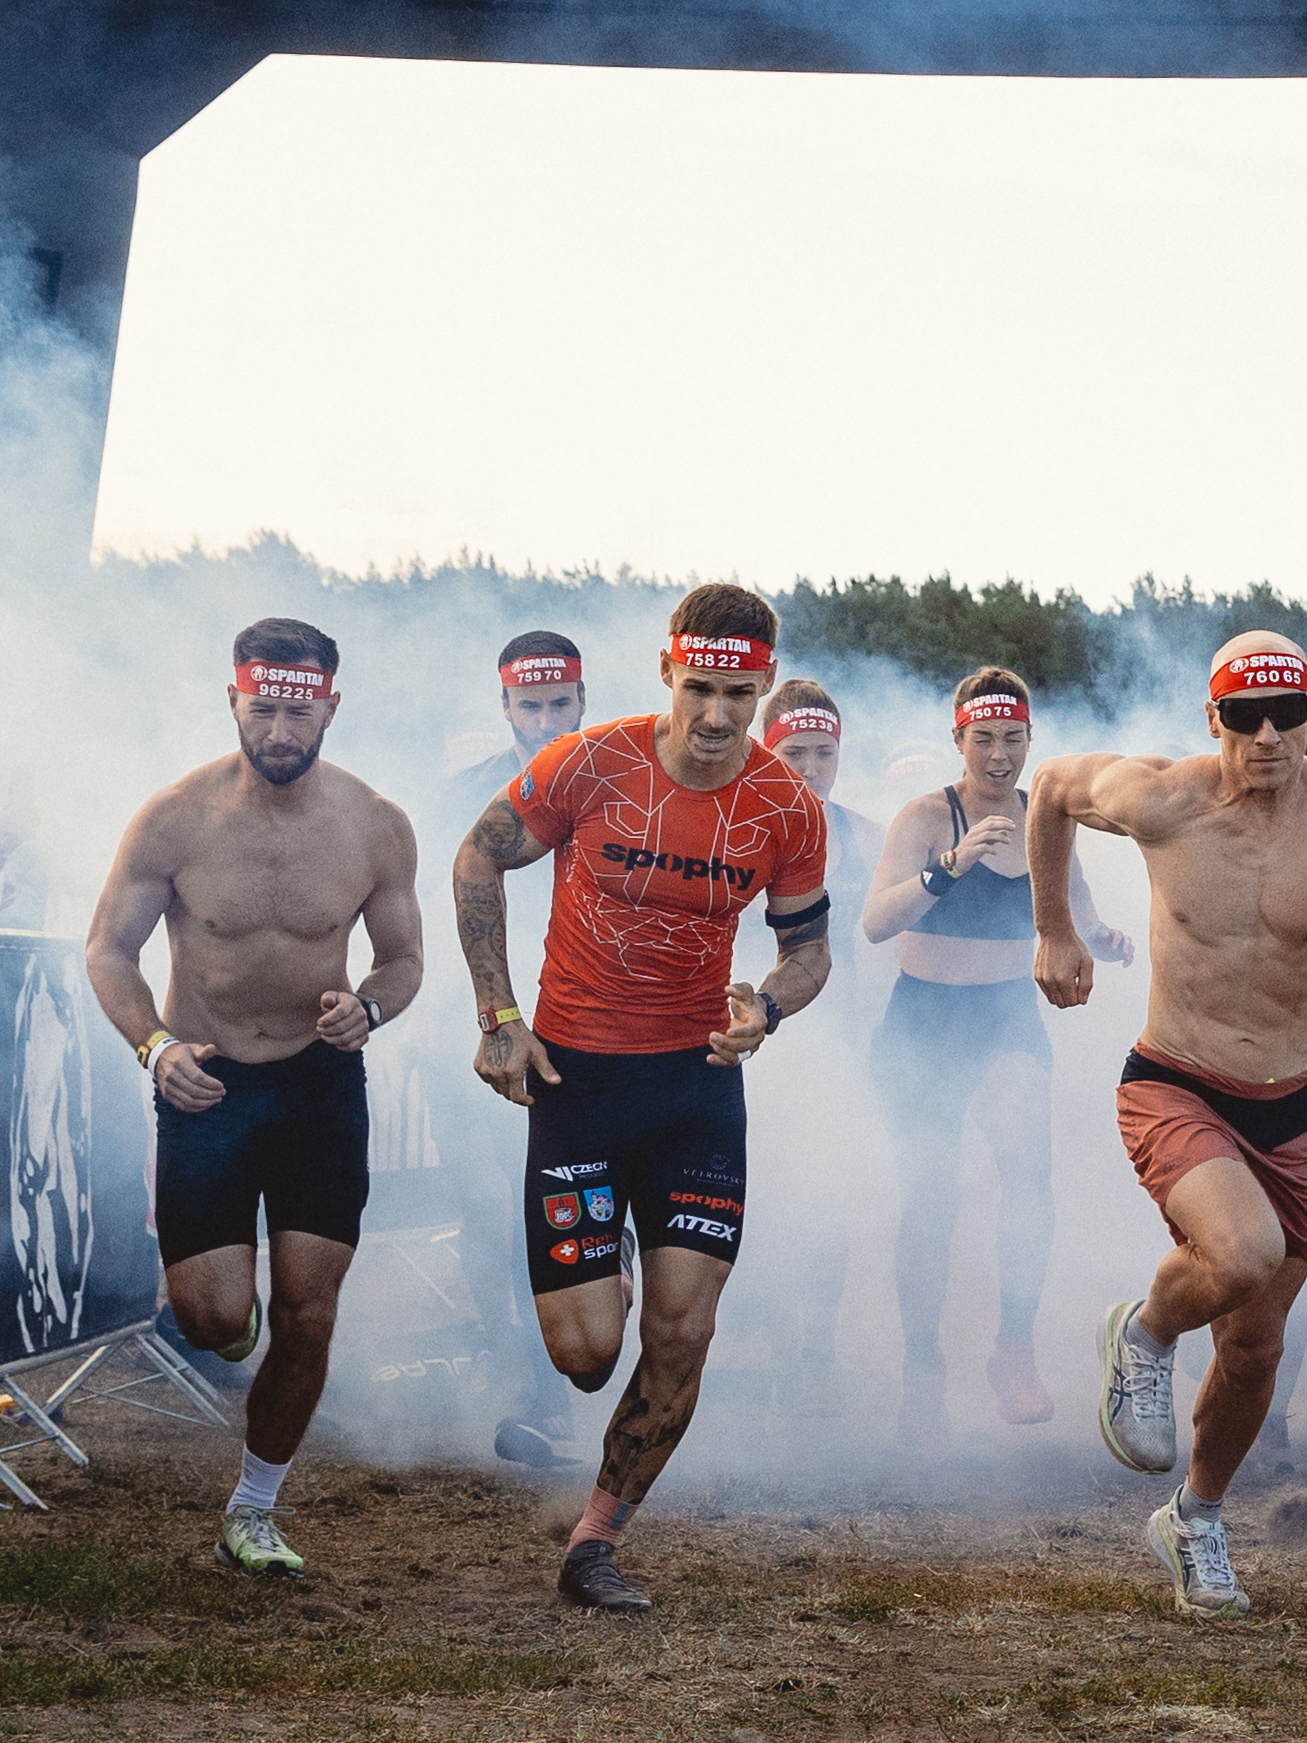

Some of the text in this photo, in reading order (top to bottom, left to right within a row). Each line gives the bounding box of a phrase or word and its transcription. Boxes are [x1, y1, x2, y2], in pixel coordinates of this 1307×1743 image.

[692, 636, 751, 654] SPARTAN
[523, 658, 566, 670] SPARTAN
[686, 653, 740, 668] 75822
[1249, 655, 1304, 673] SPARTAN
[268, 668, 324, 686] SPARTAN
[517, 670, 562, 683] 75970
[1244, 670, 1300, 685] 76065
[259, 684, 314, 700] 96225
[973, 694, 1018, 707] SPARTAN
[794, 707, 838, 725] SPARTAN
[969, 706, 1011, 720] 75075
[790, 719, 833, 732] 75238
[600, 843, 756, 891] spophy
[669, 1191, 744, 1217] spophy
[667, 1213, 737, 1242] ATEX
